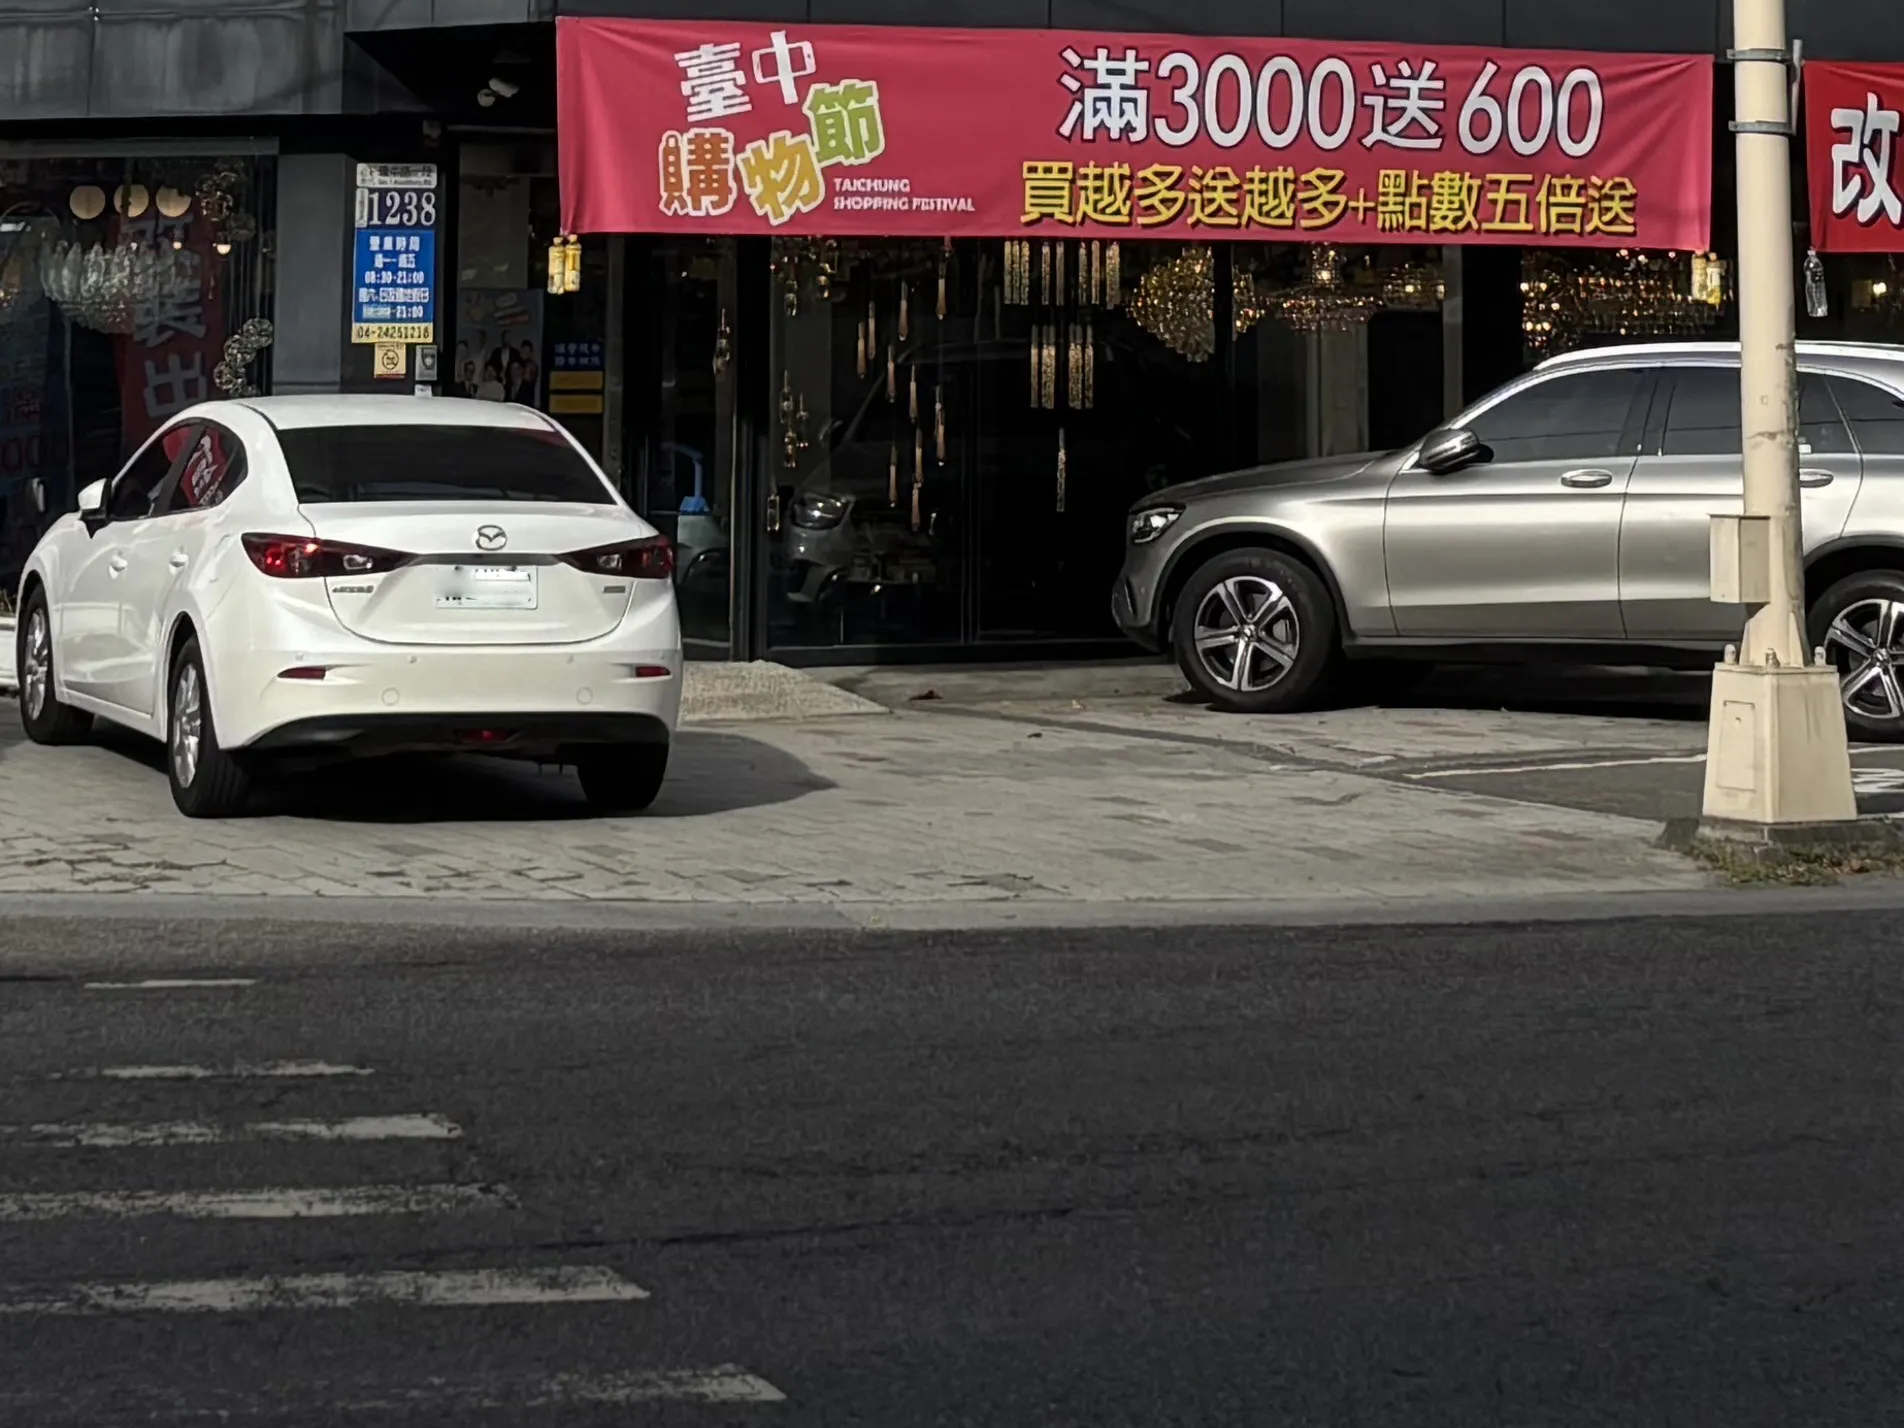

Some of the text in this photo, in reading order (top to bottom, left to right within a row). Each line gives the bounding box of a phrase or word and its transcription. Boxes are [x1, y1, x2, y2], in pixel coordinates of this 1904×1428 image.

[674, 30, 817, 122] 臺中
[833, 177, 911, 193] TAICHUNG
[1020, 160, 1638, 235] 買越多送越多+點數五倍送
[368, 190, 437, 226] 1238
[833, 197, 976, 212] SHOPPING FESTIVAL
